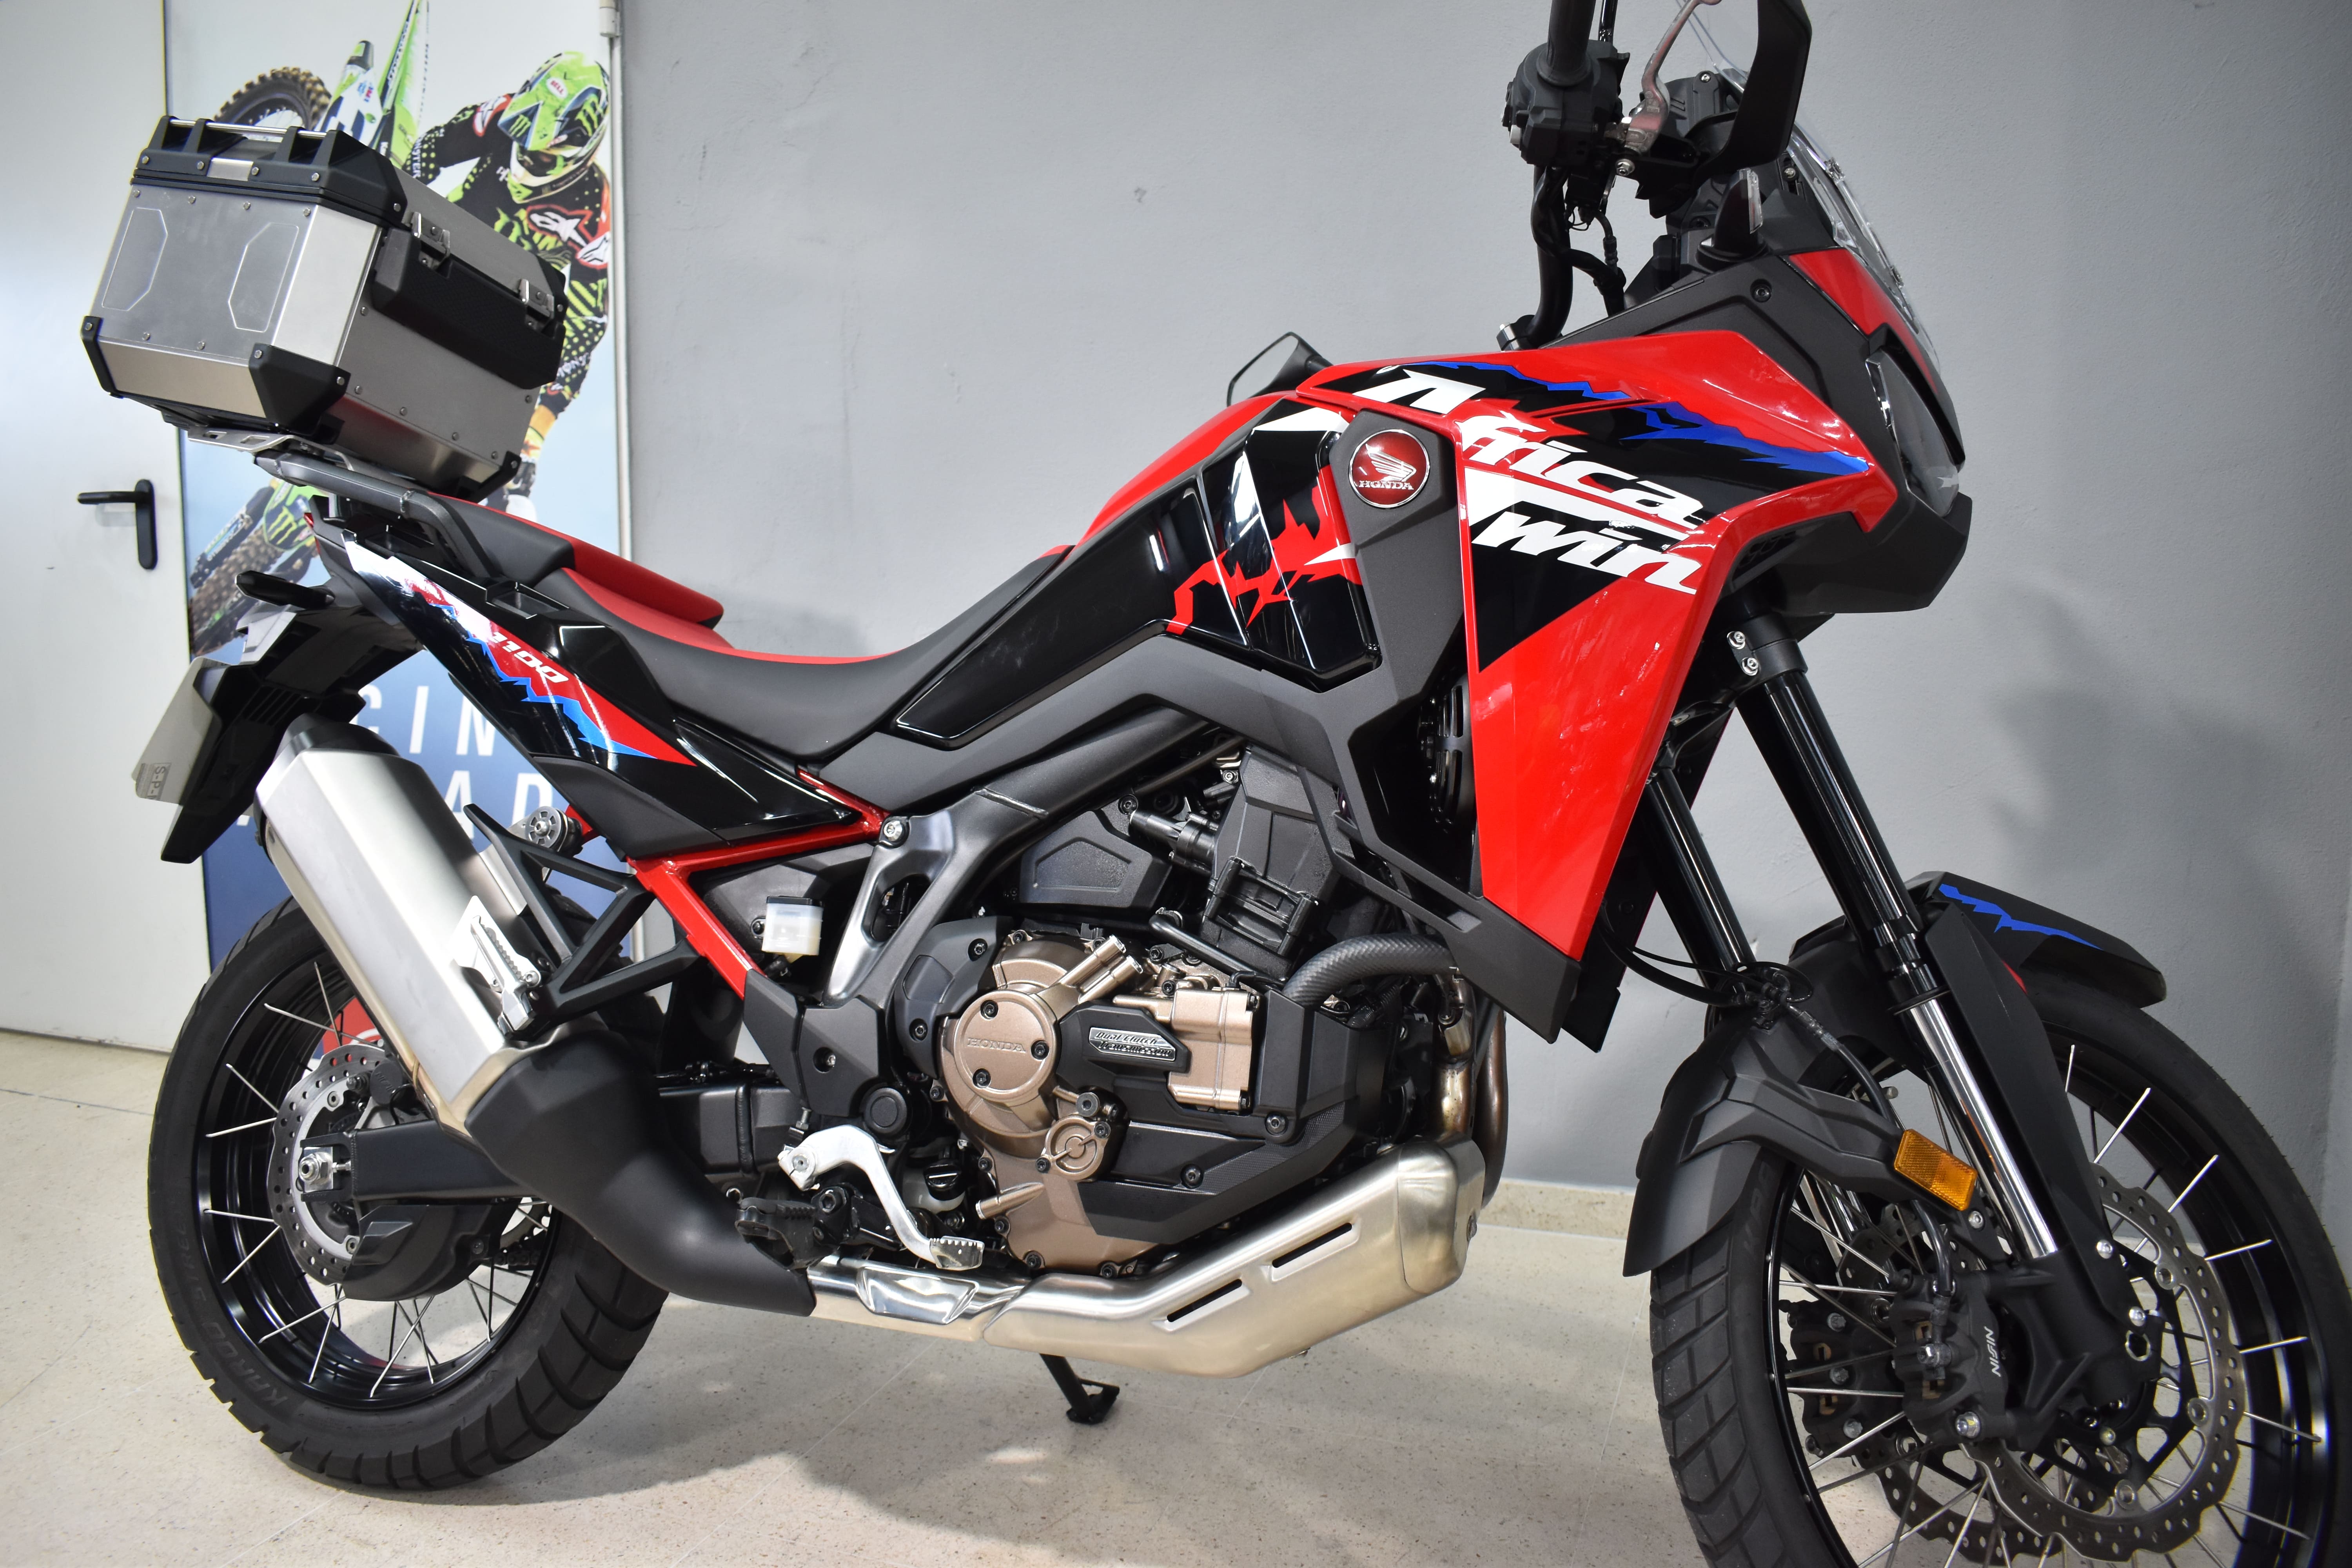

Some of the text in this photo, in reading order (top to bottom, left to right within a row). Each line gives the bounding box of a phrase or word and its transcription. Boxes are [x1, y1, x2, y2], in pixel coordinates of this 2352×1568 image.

[550, 80, 564, 94] BELL
[1359, 480, 1414, 490] HONDA
[490, 632, 569, 683] 1100
[967, 1037, 1026, 1053] HONDA
[1094, 1031, 1158, 1046] Dual Clutch
[1098, 1041, 1172, 1056] Transmission
[1984, 1326, 2001, 1377] NISSIN
